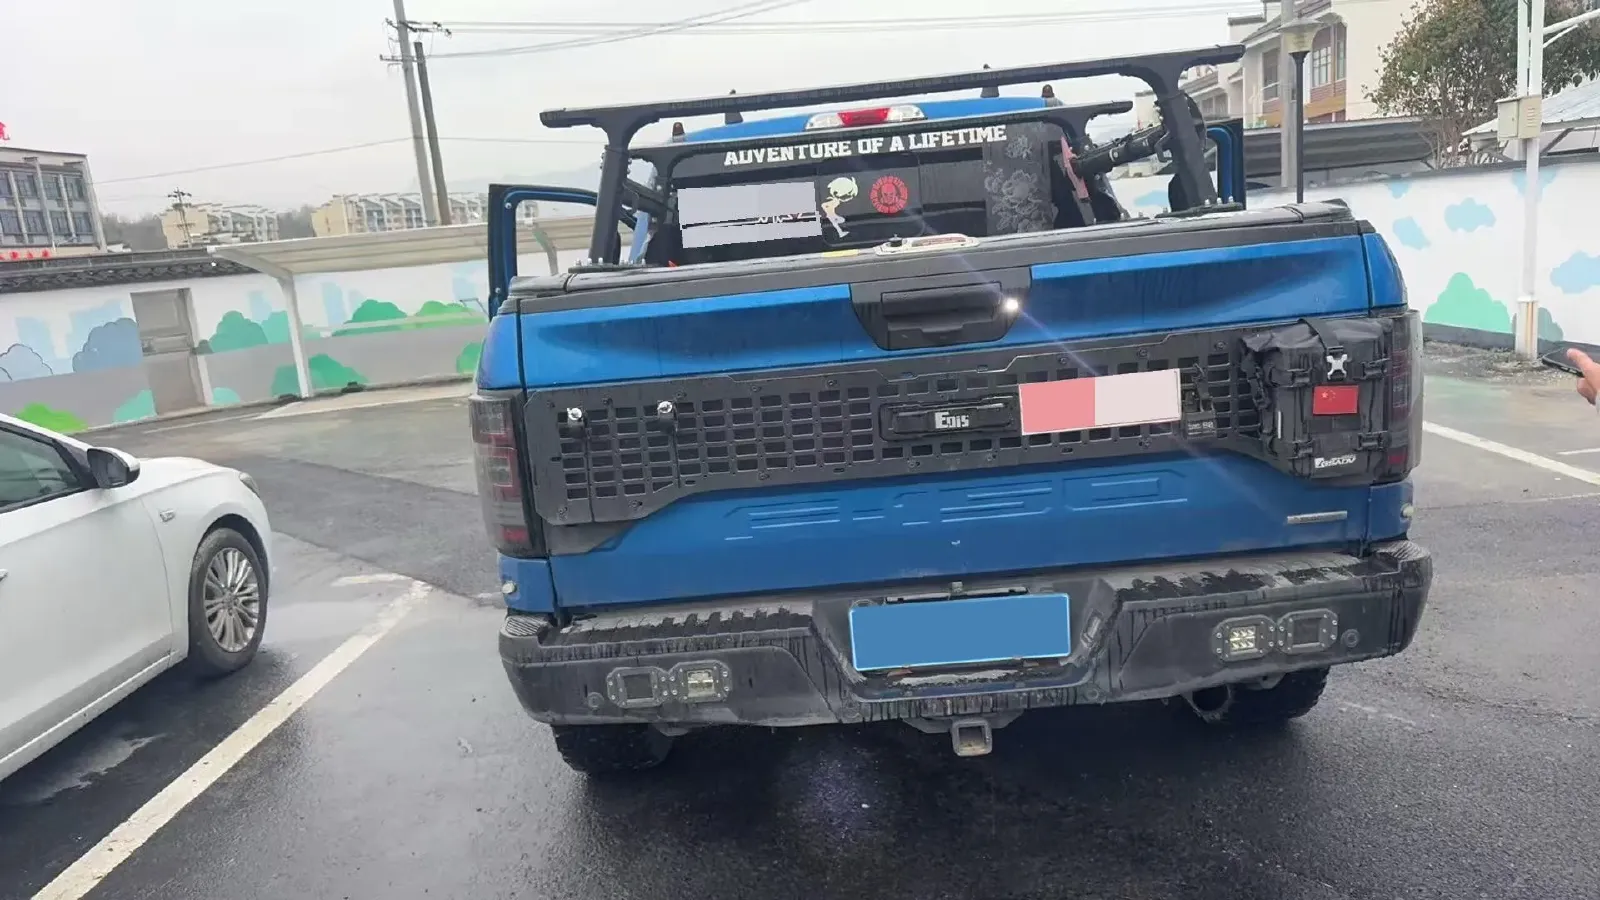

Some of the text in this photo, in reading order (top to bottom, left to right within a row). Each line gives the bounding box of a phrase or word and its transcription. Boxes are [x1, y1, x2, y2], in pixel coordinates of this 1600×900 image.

[724, 125, 1008, 166] ADVENTURE OF A LIFETIME
